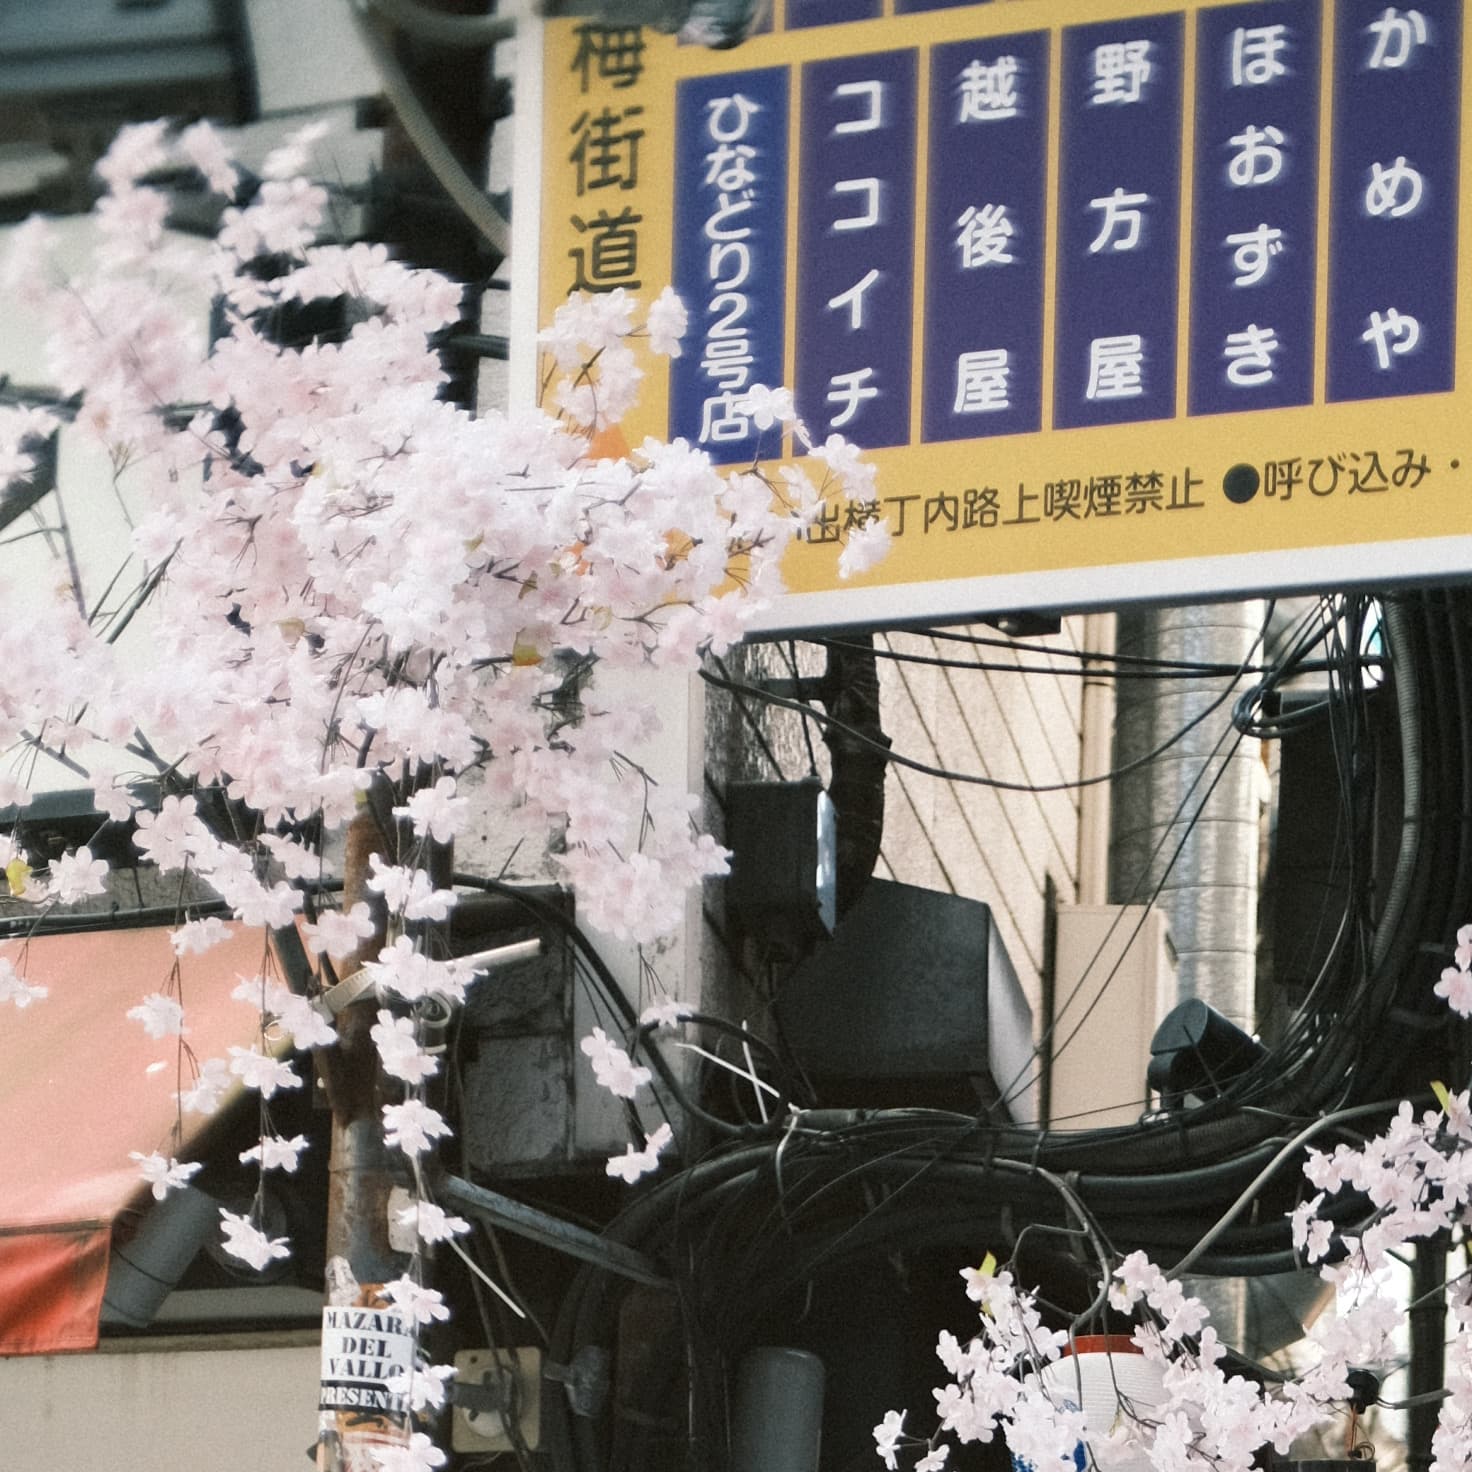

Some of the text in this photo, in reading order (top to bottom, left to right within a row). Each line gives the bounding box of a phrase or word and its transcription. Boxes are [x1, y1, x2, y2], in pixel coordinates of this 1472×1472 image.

[827, 79, 884, 428] ココイチ
[953, 55, 1020, 415] 越後屋
[1086, 39, 1151, 401] 野方屋
[1223, 25, 1287, 387] ほおずき
[1362, 7, 1427, 370] かめや
[341, 1335, 392, 1359] DEL
